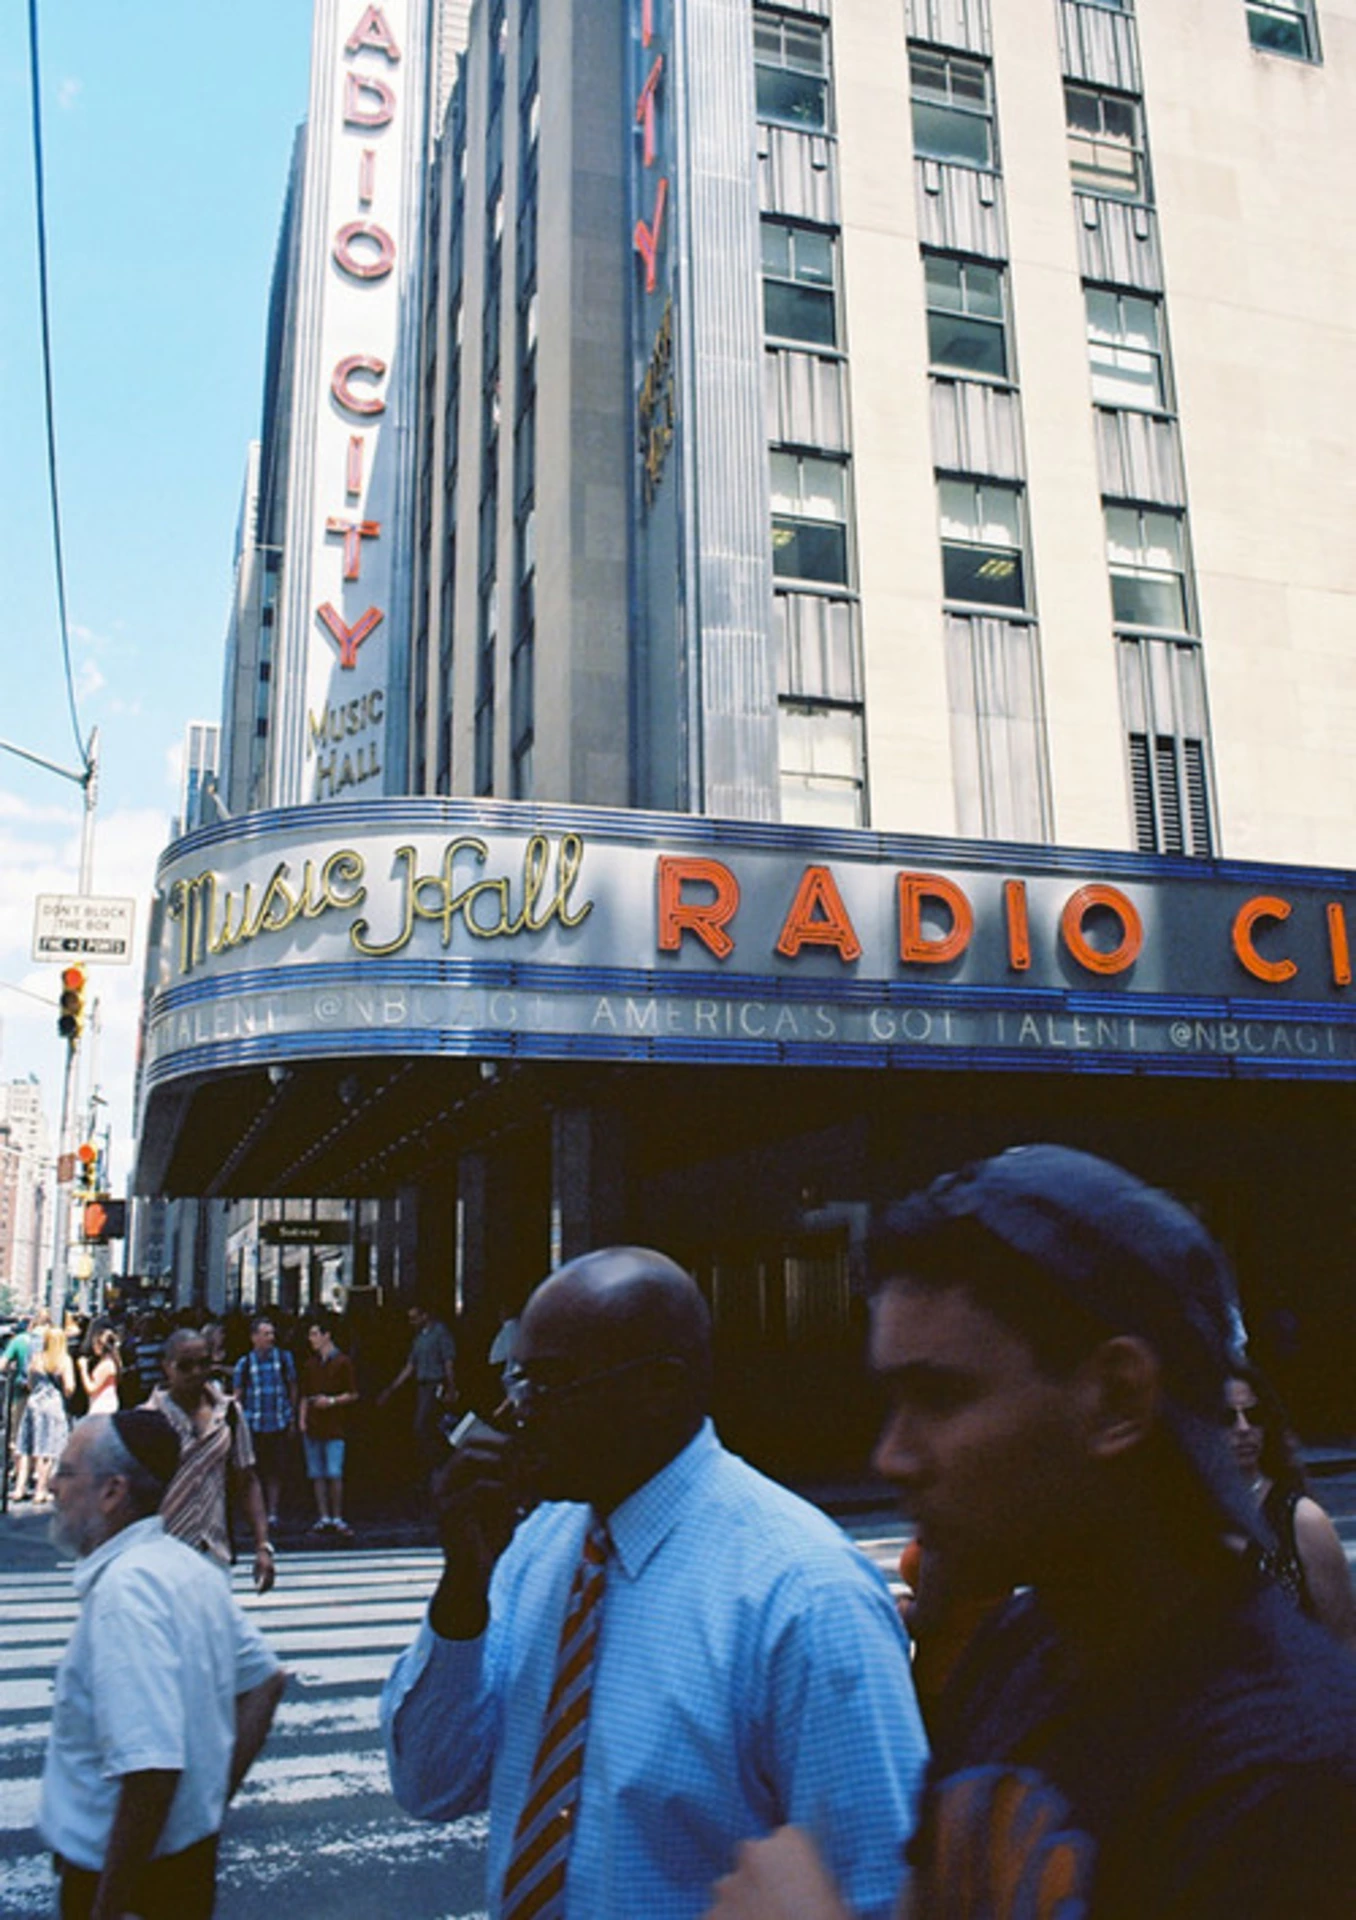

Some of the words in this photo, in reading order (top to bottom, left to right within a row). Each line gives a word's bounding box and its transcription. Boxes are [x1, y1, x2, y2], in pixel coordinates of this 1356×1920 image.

[316, 354, 387, 670] CITY
[306, 689, 384, 761] MUSIC
[316, 740, 382, 802] HALL
[58, 919, 80, 931] THE
[85, 920, 109, 932] BOX
[85, 905, 125, 919] BLOCK
[168, 849, 367, 974] Music
[349, 833, 594, 956] Hall
[657, 853, 1144, 976] RADIO
[1231, 894, 1354, 986] CI
[590, 996, 837, 1038] AMERICA'S
[868, 1007, 961, 1040] GOT
[990, 1011, 1143, 1048] TALENT
